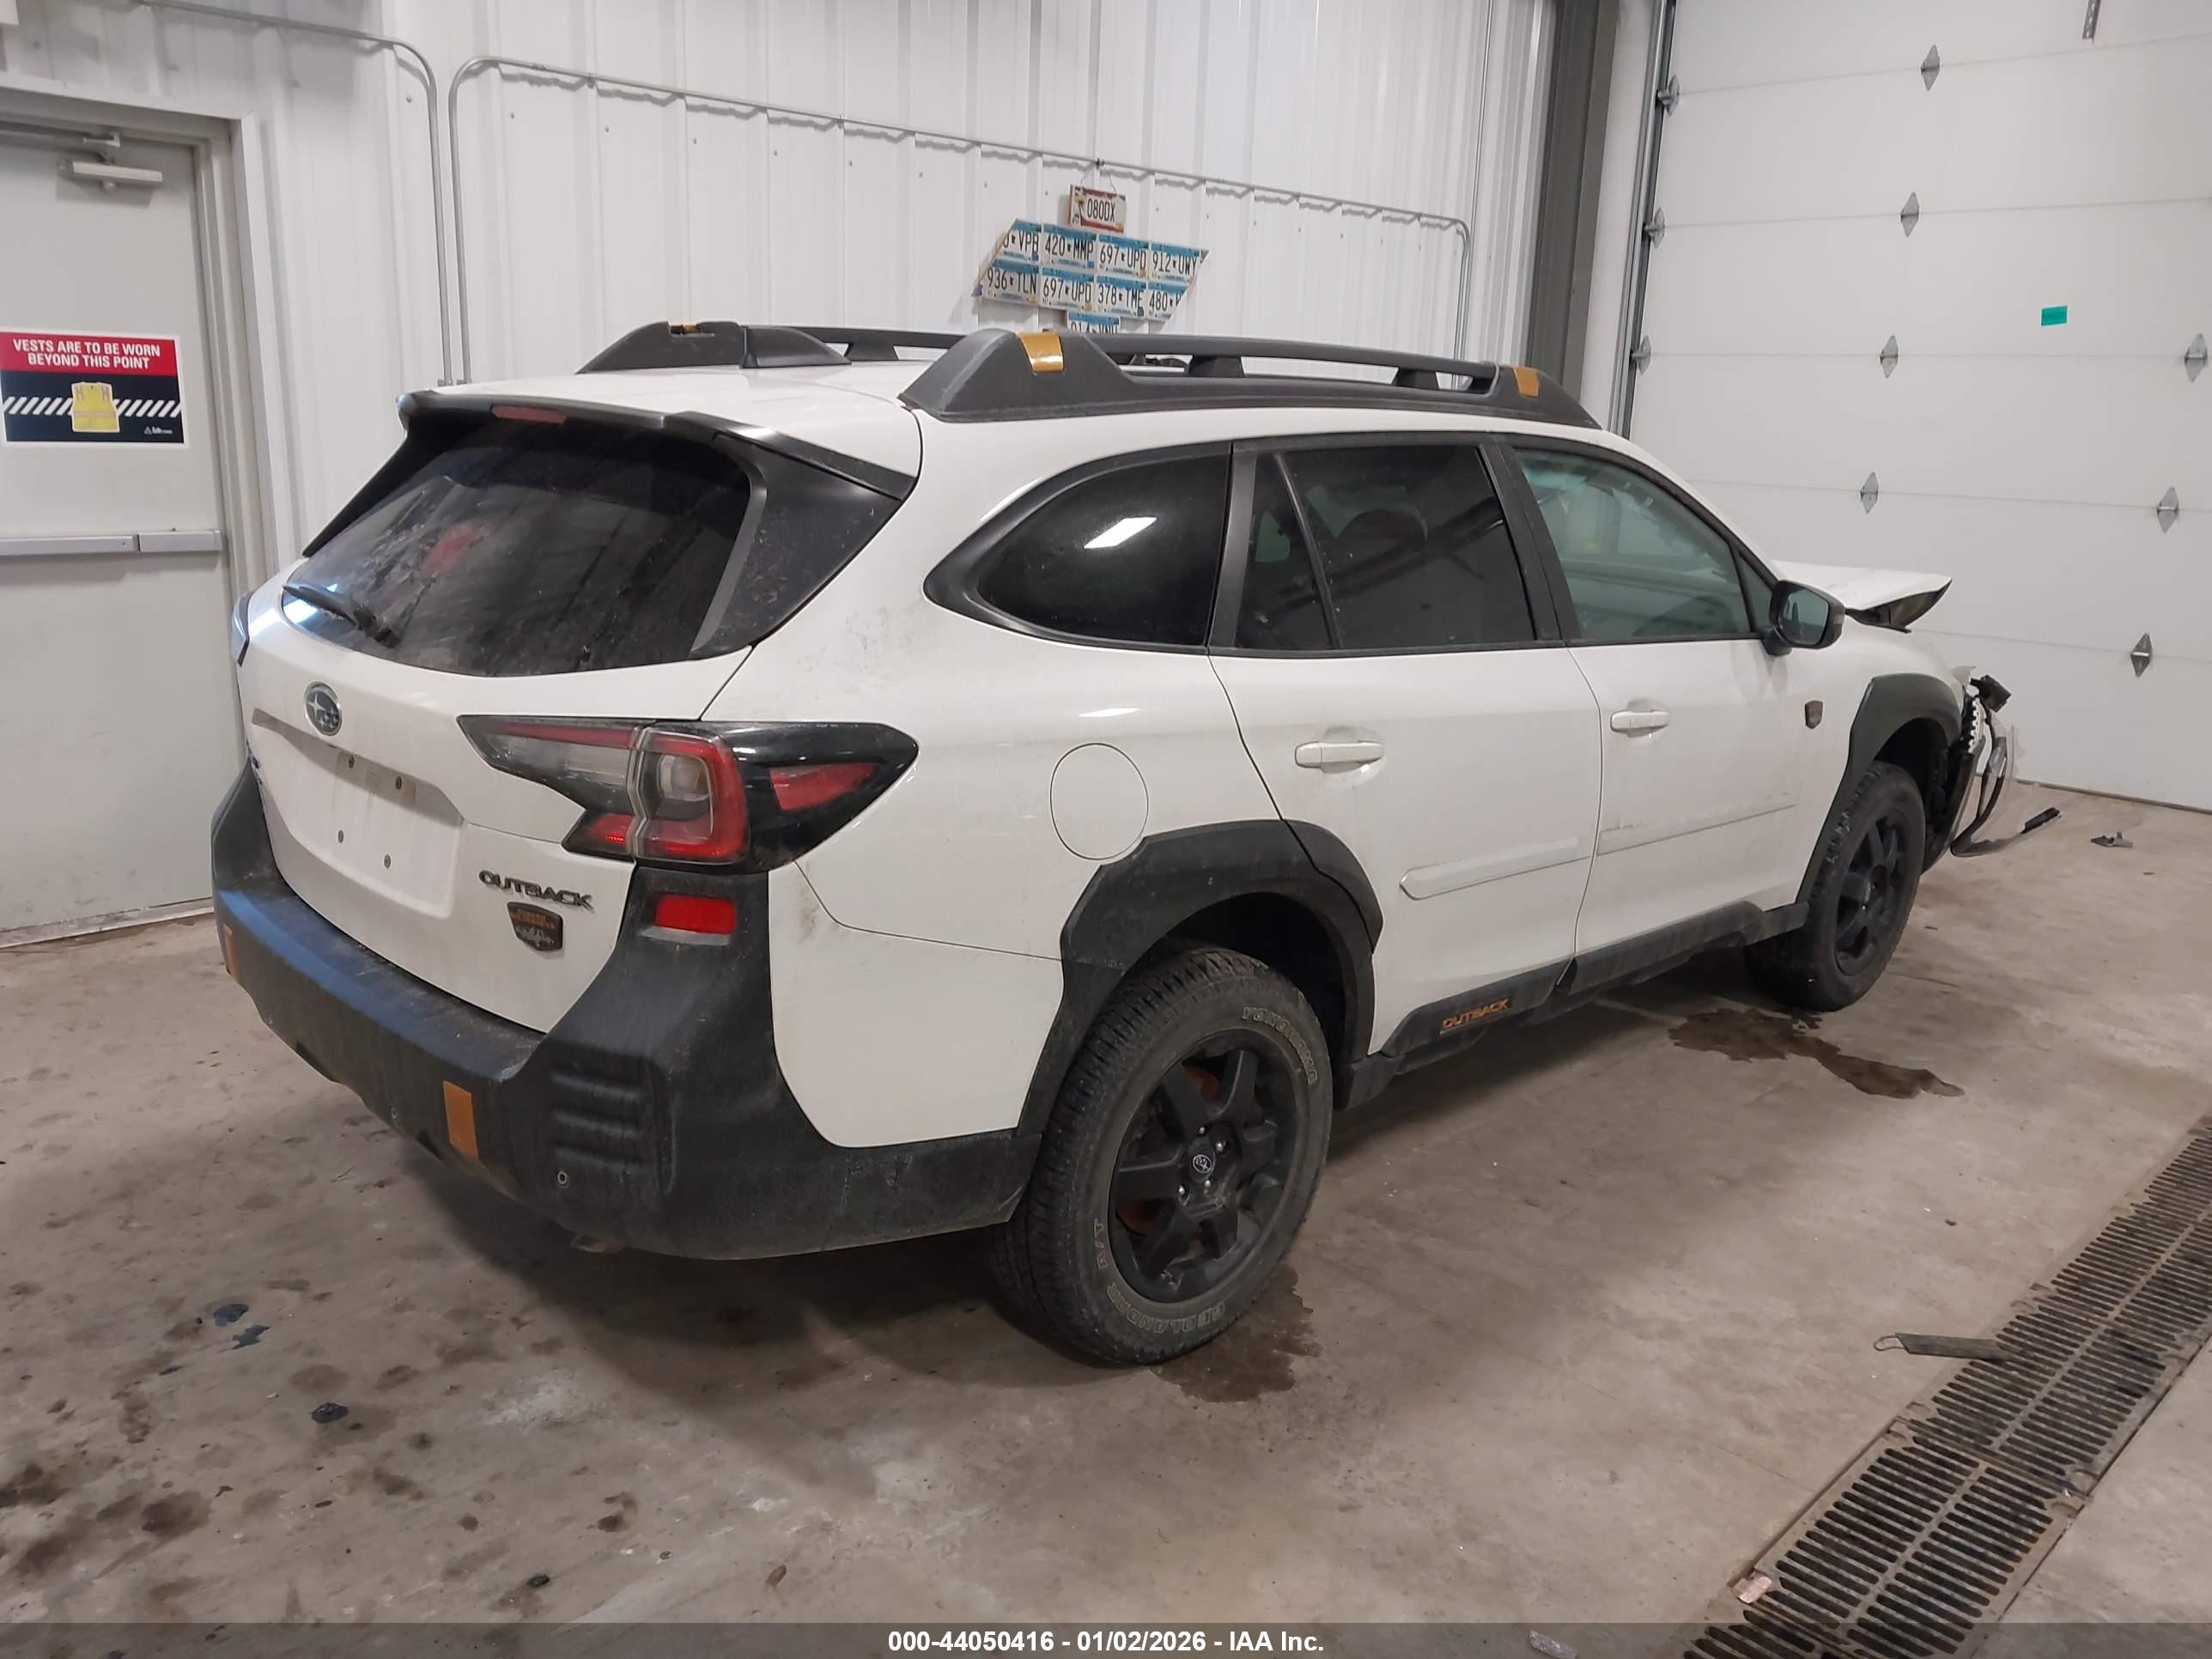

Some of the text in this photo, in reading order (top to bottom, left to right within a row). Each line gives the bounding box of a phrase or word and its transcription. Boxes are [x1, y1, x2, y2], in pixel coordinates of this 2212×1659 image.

[13, 339, 161, 357] VESTS ARE TO BE WORN
[27, 353, 150, 369] BEYOND THIS POINT
[479, 870, 594, 913] OUTBACK
[1443, 996, 1510, 1030] OUTBACK
